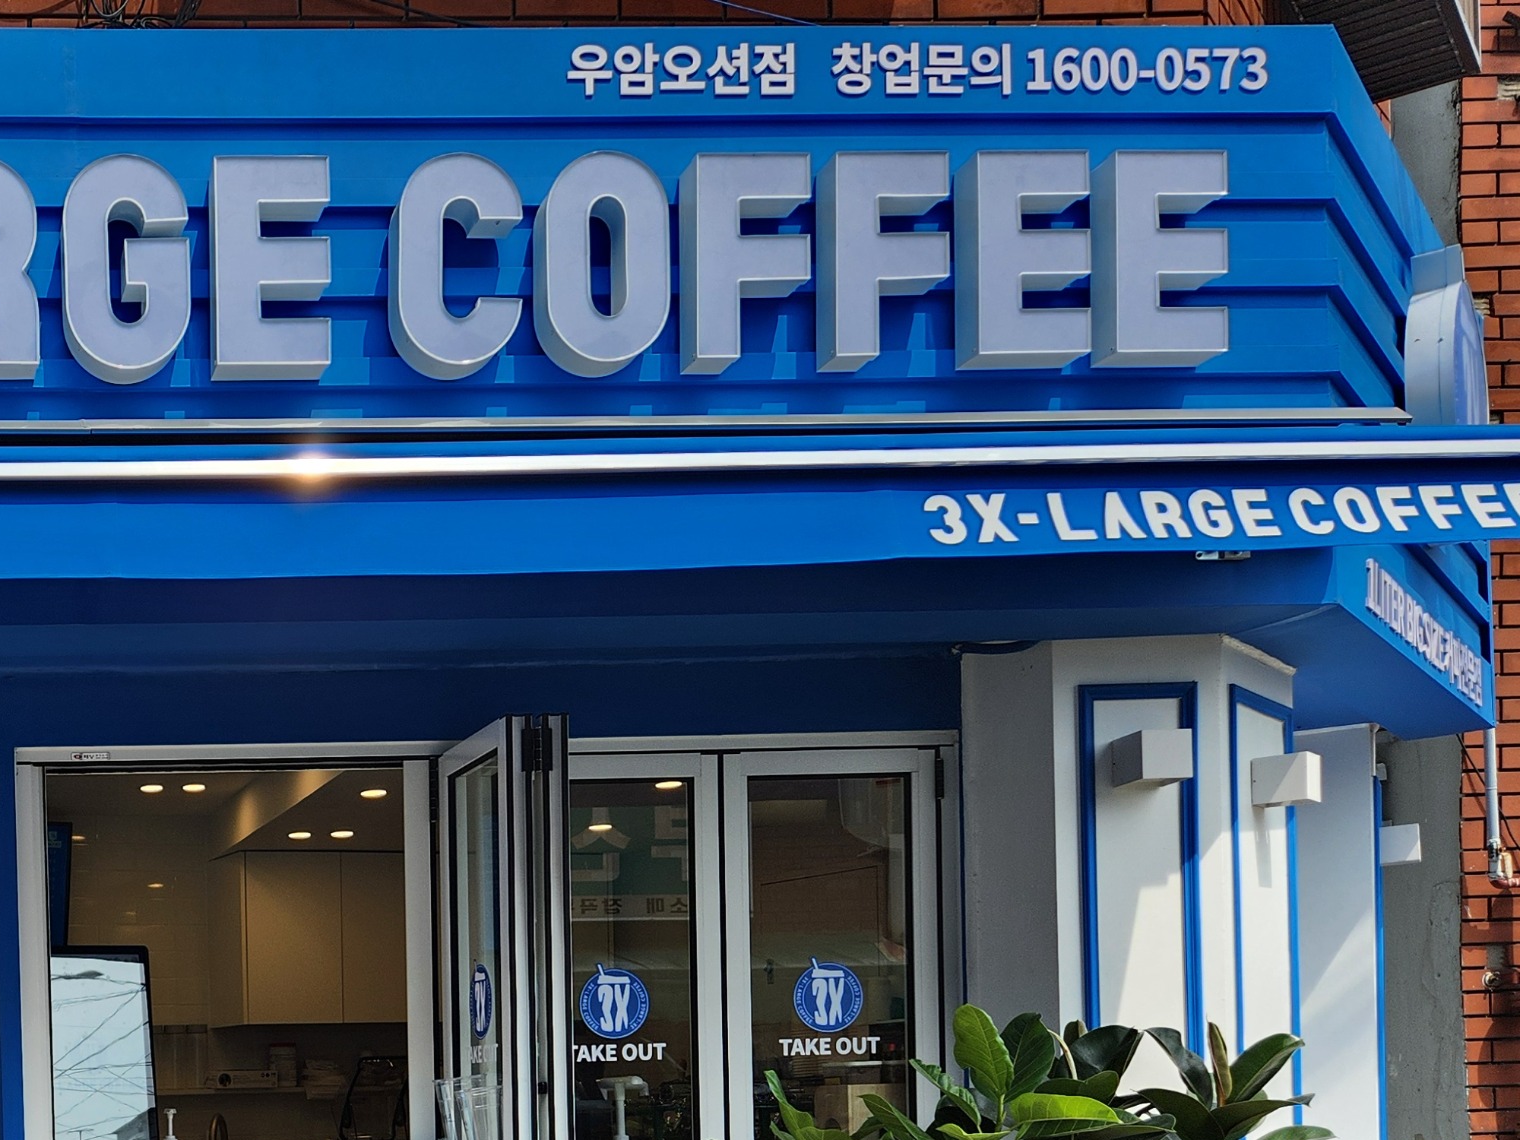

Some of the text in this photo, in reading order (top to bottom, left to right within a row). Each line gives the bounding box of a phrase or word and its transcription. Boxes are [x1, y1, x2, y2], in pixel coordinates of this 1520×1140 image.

[566, 43, 1269, 96] 우암오션점 창업문의 1600-0573
[388, 149, 1229, 381] COFFEE
[922, 487, 1282, 544] 3X-LARGE
[622, 1042, 667, 1062] OUT
[779, 1036, 881, 1057] TAKE OUT
